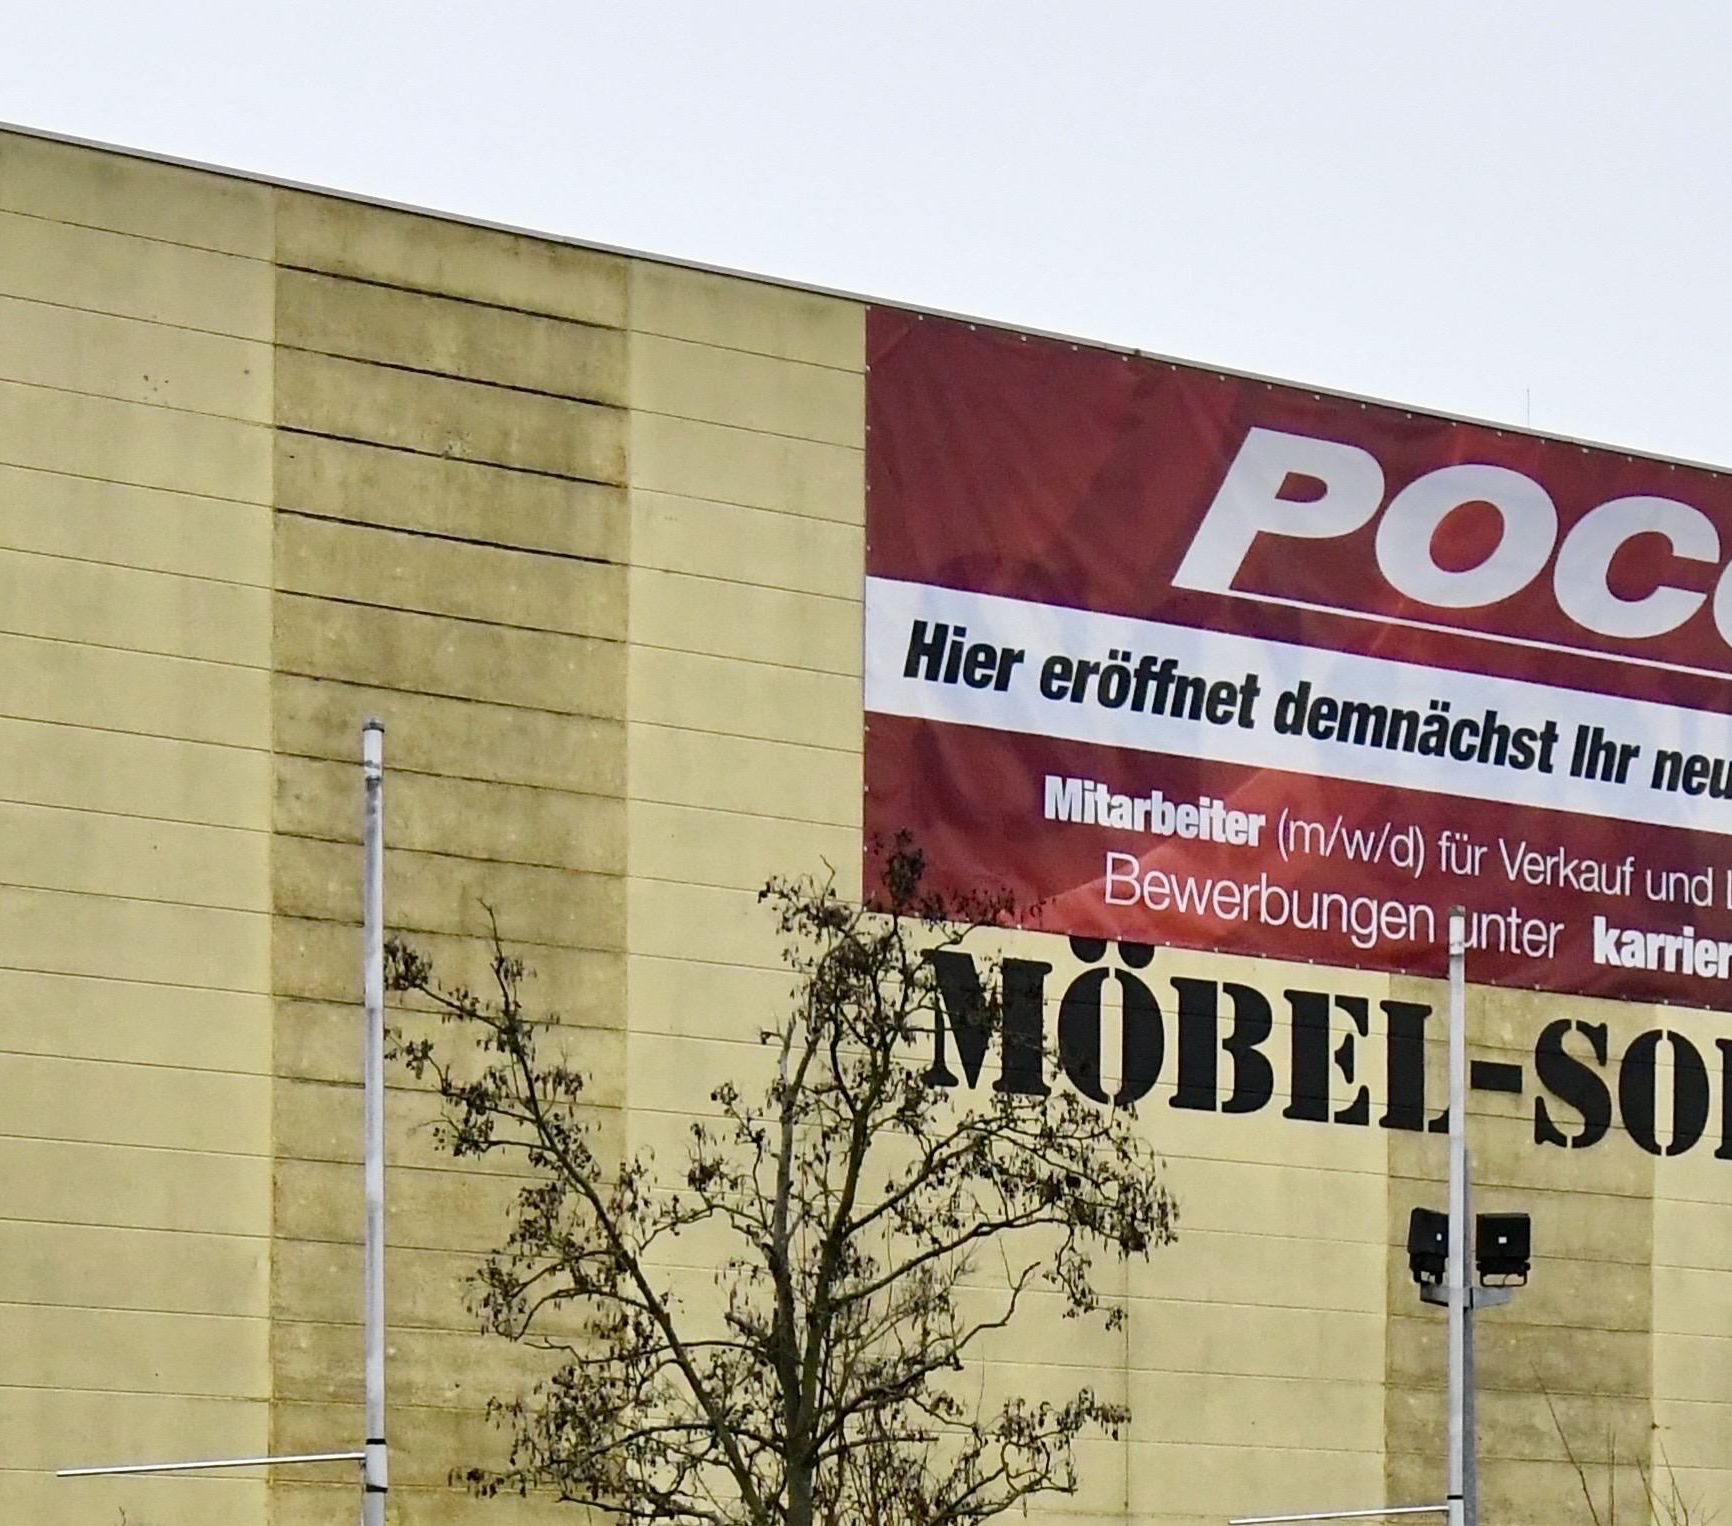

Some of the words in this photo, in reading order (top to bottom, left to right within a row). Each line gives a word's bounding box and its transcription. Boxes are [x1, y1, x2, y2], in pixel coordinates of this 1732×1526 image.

[903, 620, 1024, 692] Hier
[1040, 649, 1261, 729] eröffnet
[1273, 681, 1558, 774] demnächst
[1570, 725, 1640, 783] Ihr
[1045, 775, 1266, 847] Mitarbeiter
[1277, 808, 1425, 878] (m/w/d)
[1438, 829, 1488, 876] für
[1498, 838, 1635, 895] Verkauf
[1646, 868, 1713, 906] und
[1105, 852, 1434, 946] Bewerbungen
